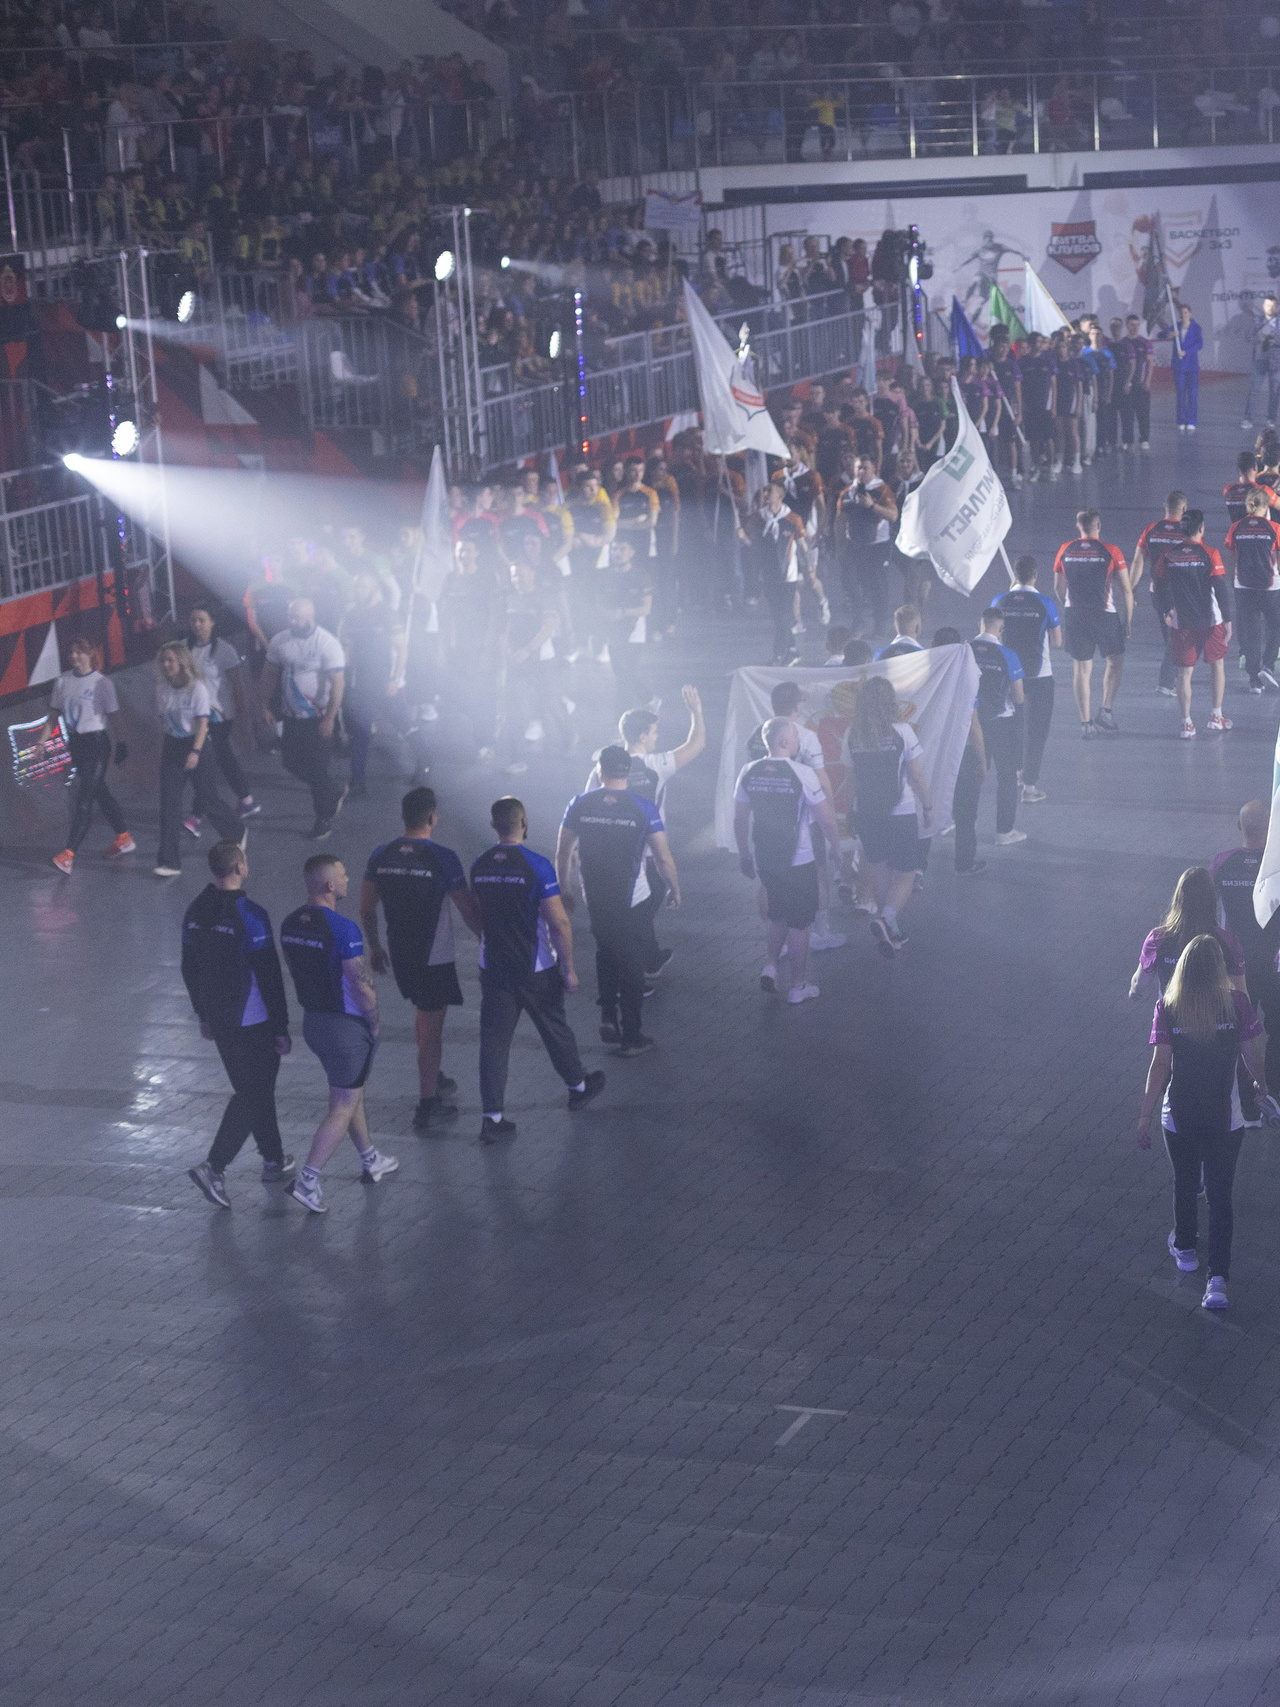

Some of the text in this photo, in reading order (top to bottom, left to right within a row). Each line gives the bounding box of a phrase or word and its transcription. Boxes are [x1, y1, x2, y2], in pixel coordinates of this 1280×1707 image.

[1169, 227, 1240, 240] БАСКЕТБОЛ
[1051, 235, 1097, 245] БИТВА
[1047, 244, 1101, 255] КЛУБОВ
[376, 866, 433, 879] БИЗНЕС-ЛИГА
[474, 876, 526, 885] БИЗНЕС-ЛИГА
